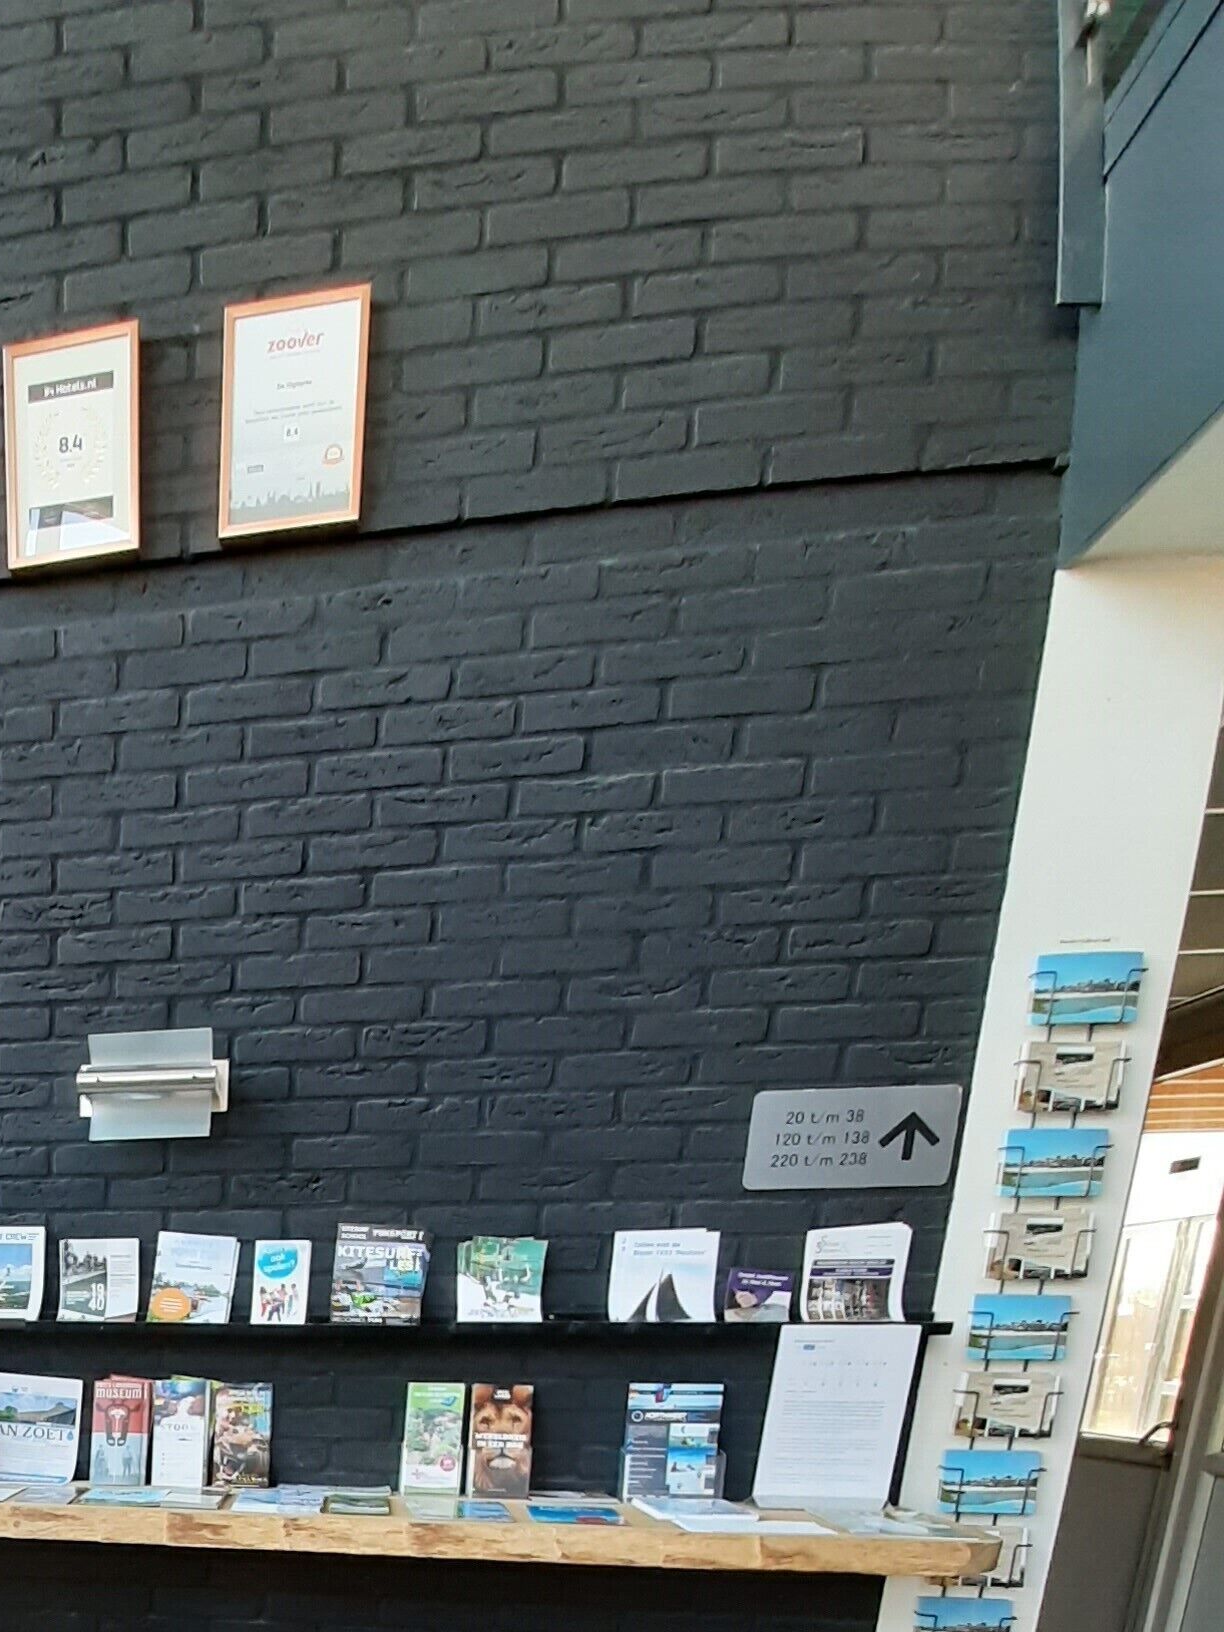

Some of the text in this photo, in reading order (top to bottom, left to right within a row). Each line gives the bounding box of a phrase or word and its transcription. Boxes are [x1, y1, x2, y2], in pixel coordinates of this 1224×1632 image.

[267, 331, 324, 353] zoover
[59, 434, 83, 454] 8.4
[785, 1109, 865, 1126] 20 t/m 38
[775, 1131, 871, 1146] 120 t/m 138
[770, 1152, 868, 1168] 220 t/m 238
[23, 1426, 63, 1441] ZOET
